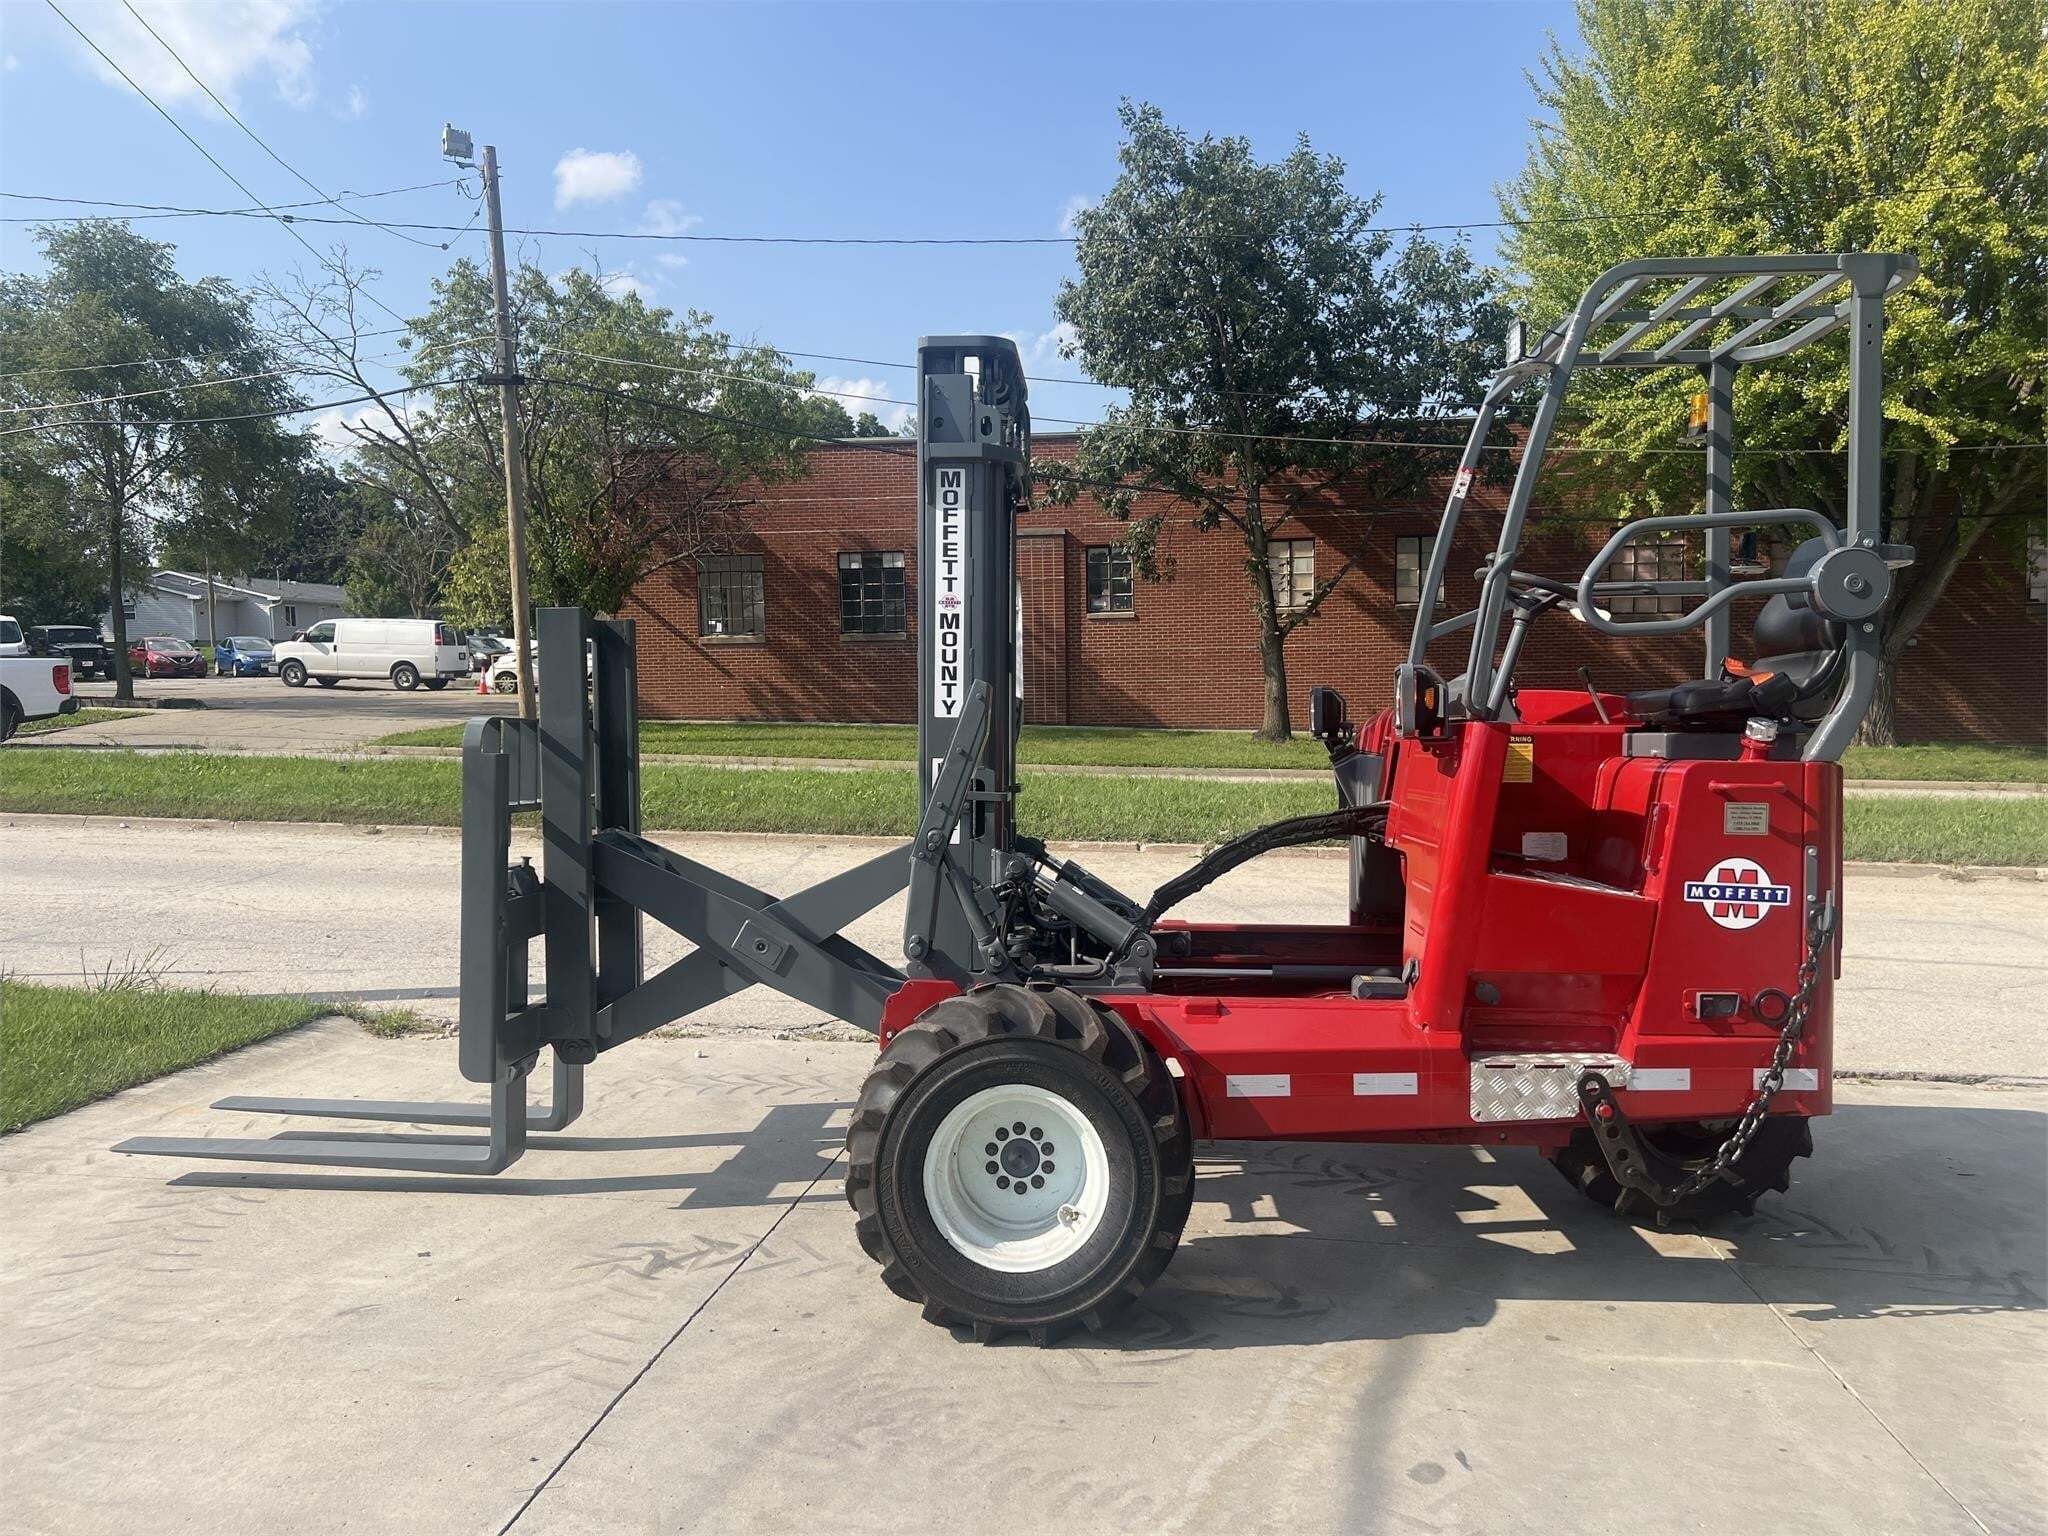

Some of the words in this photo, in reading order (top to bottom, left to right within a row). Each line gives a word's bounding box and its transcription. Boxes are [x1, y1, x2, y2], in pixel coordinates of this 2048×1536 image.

[940, 471, 961, 593] MOFFETT
[939, 613, 960, 715] MOUNTY
[1690, 886, 1785, 900] MOFFETT
